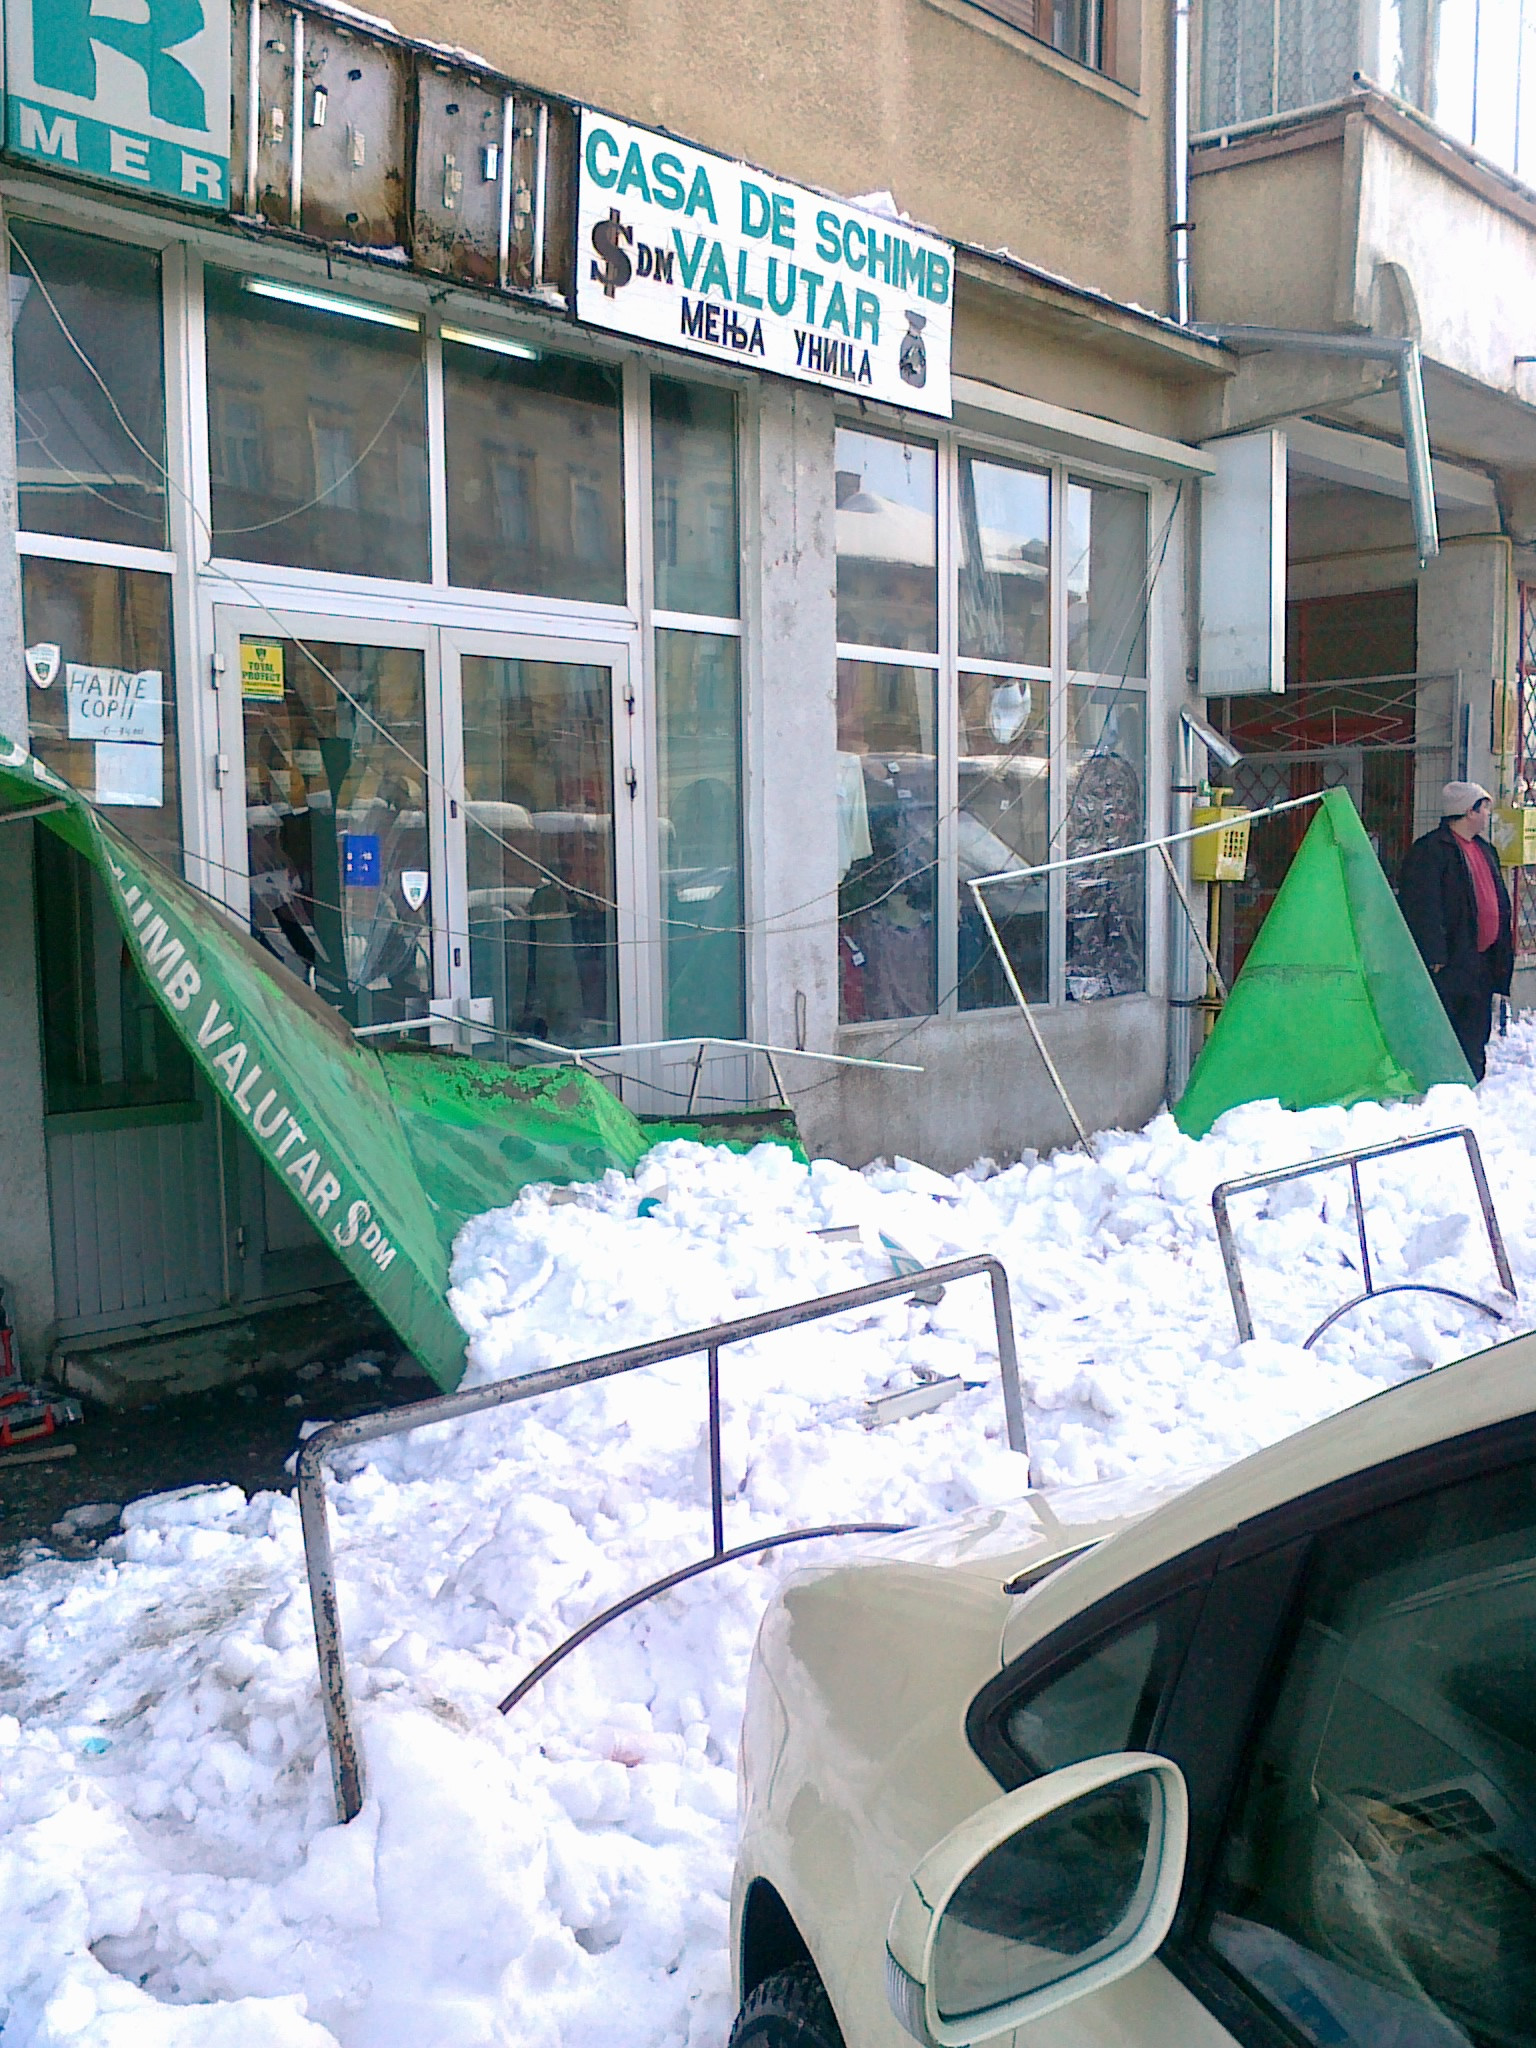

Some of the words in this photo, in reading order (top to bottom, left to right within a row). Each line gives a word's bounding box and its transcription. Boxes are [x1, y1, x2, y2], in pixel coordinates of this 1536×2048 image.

[585, 127, 718, 225] CASA
[741, 179, 796, 251] DE
[815, 209, 950, 305] SCHIMB
[672, 227, 880, 346] VALUTAR
[69, 671, 148, 699] HAINE
[197, 1000, 341, 1218] VALUTAR
